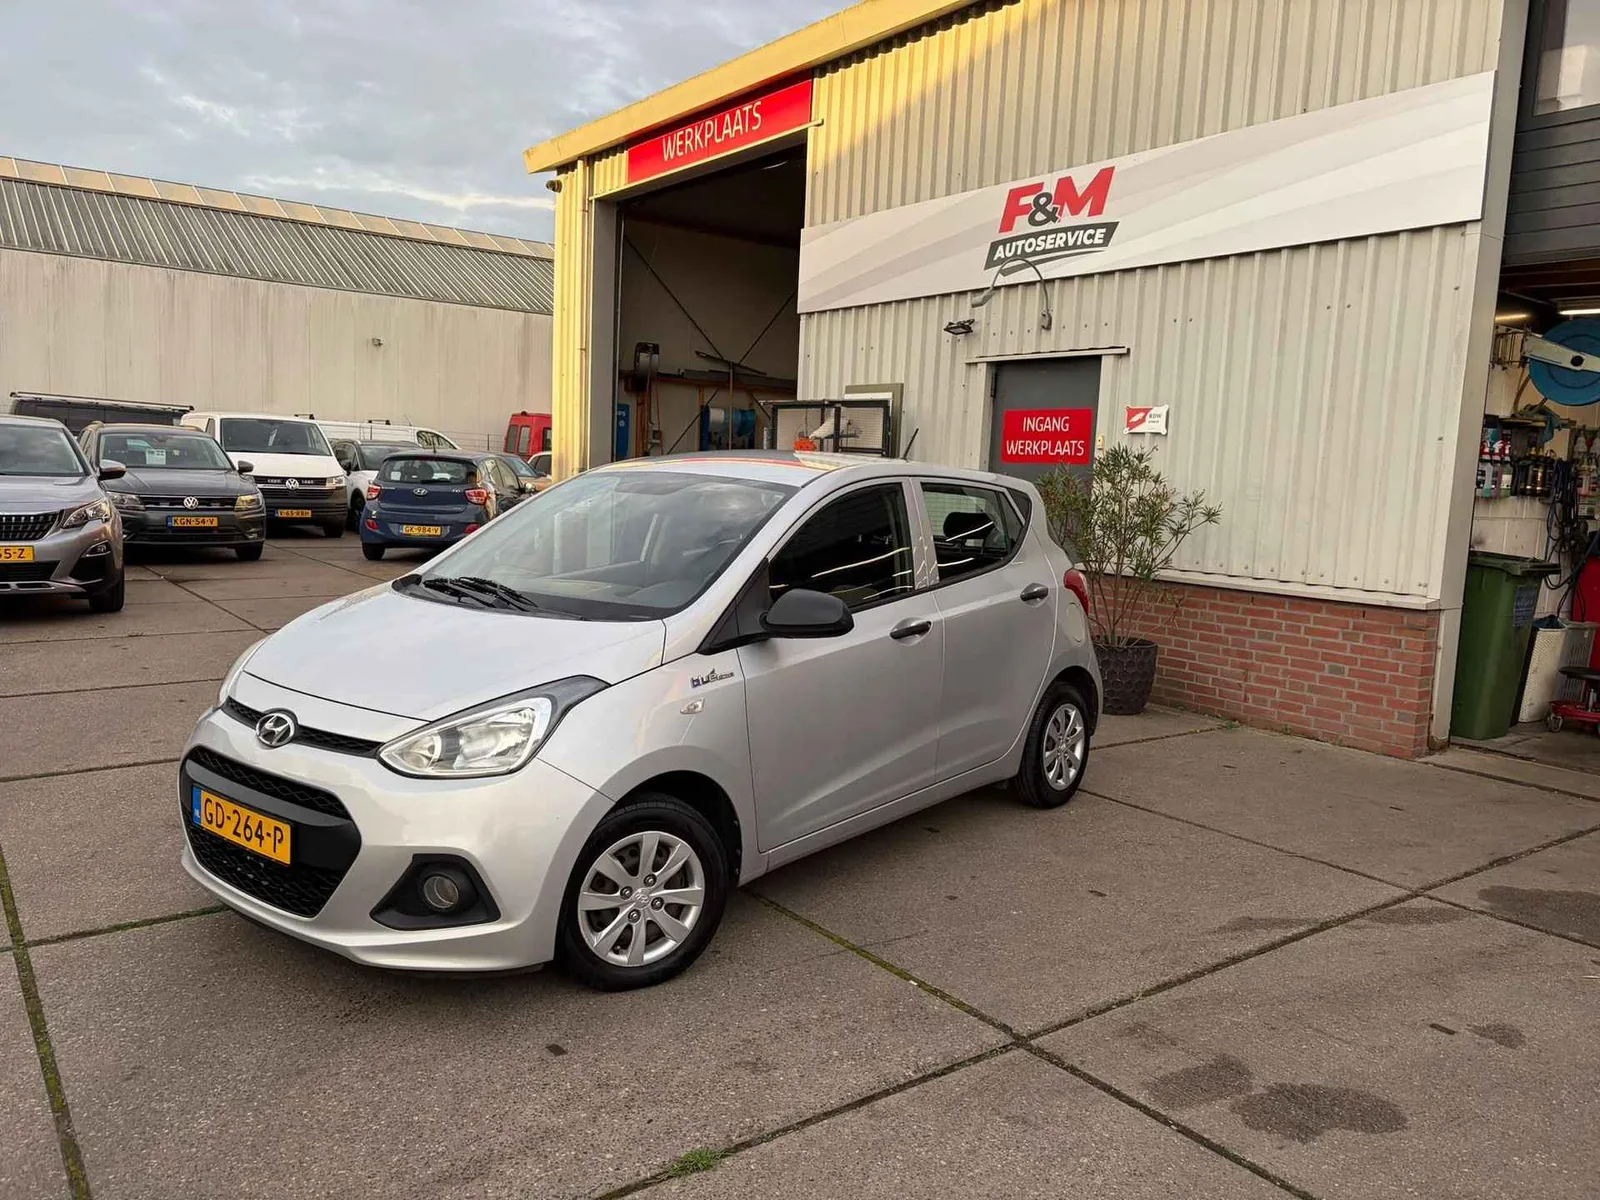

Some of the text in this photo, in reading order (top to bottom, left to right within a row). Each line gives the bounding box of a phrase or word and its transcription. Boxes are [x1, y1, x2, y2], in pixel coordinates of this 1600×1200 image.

[662, 101, 762, 161] WERKPLAATS
[999, 166, 1115, 233] F&M
[993, 228, 1106, 260] AUTOSERVICE
[1023, 416, 1070, 432] INGANG
[1006, 440, 1085, 457] WERKPLAATS
[404, 526, 440, 534] GK-984-V
[204, 797, 284, 854] GD-264-P
